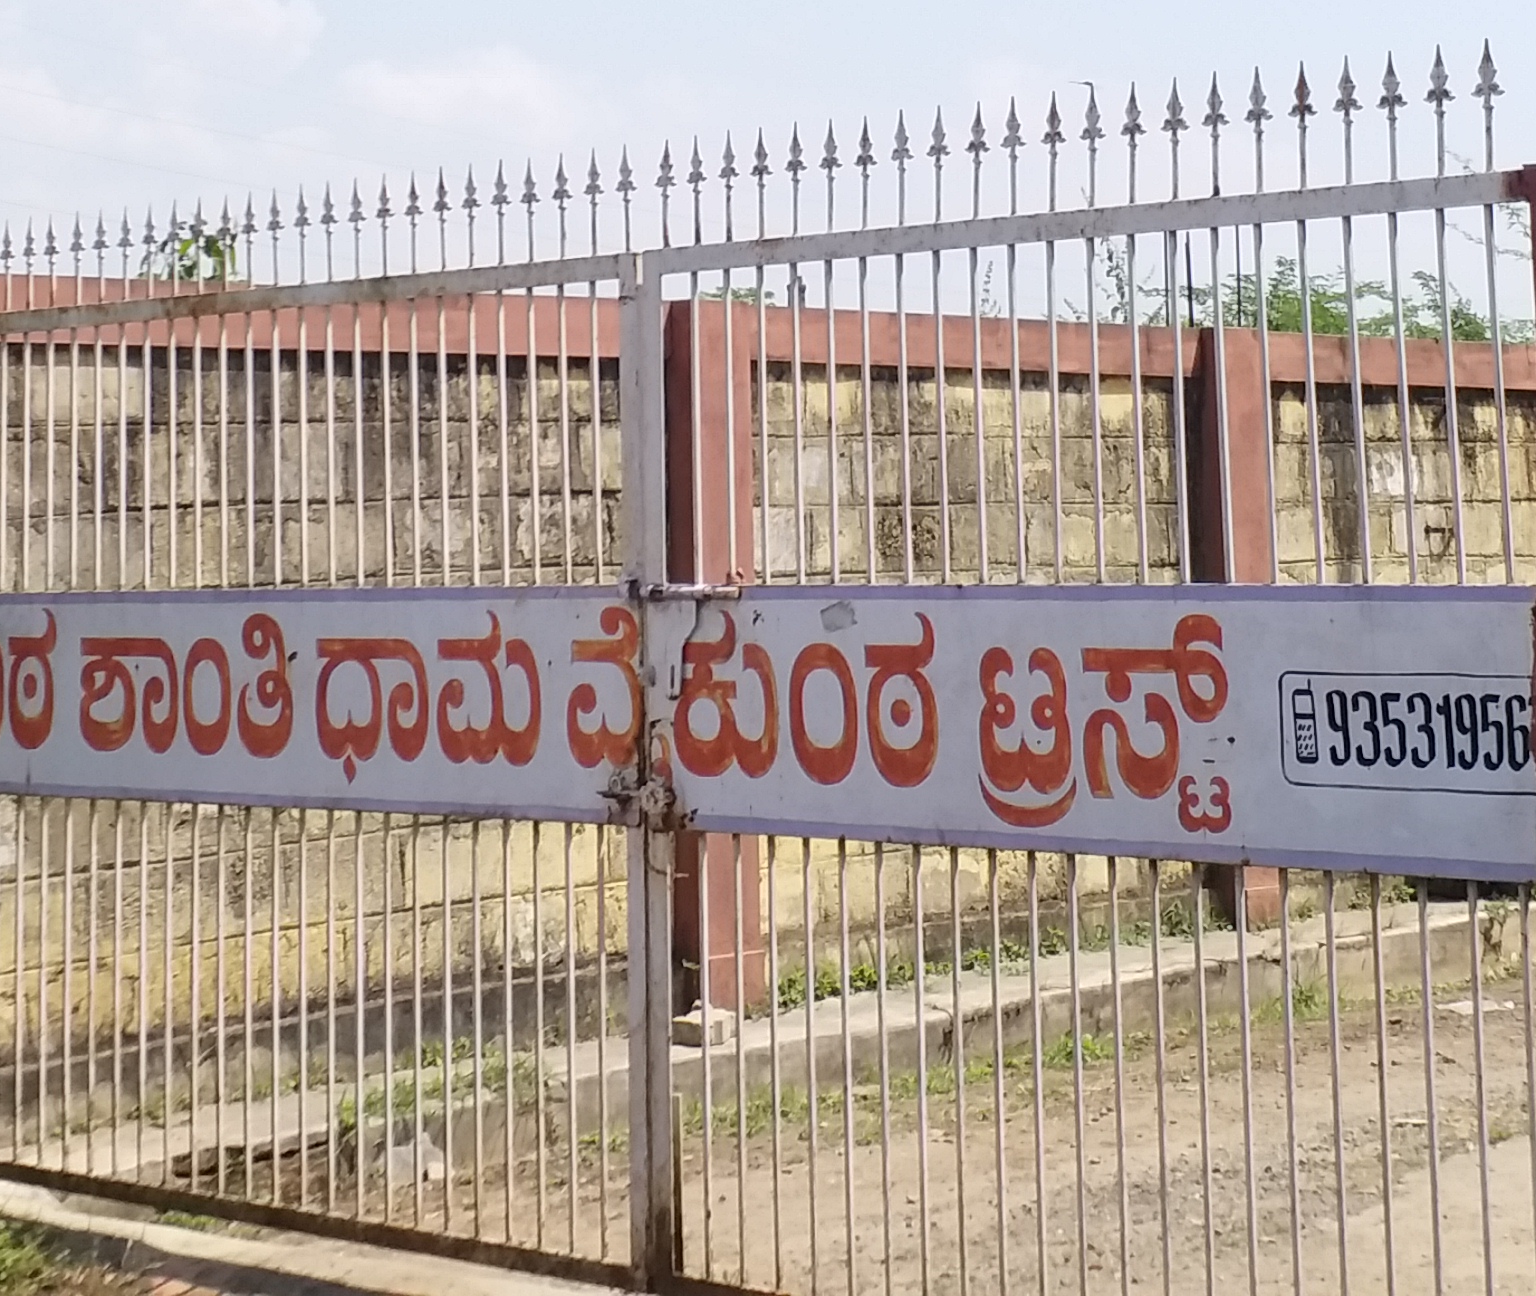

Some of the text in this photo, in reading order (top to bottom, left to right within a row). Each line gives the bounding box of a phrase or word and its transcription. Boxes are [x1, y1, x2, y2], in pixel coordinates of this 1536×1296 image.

[79, 613, 293, 758] ಶಾಂತಿ
[316, 609, 541, 785] ಧಾಮ
[979, 613, 1232, 833] ಟ್ರಸ್ಟ್
[1325, 690, 1534, 771] 93531956
